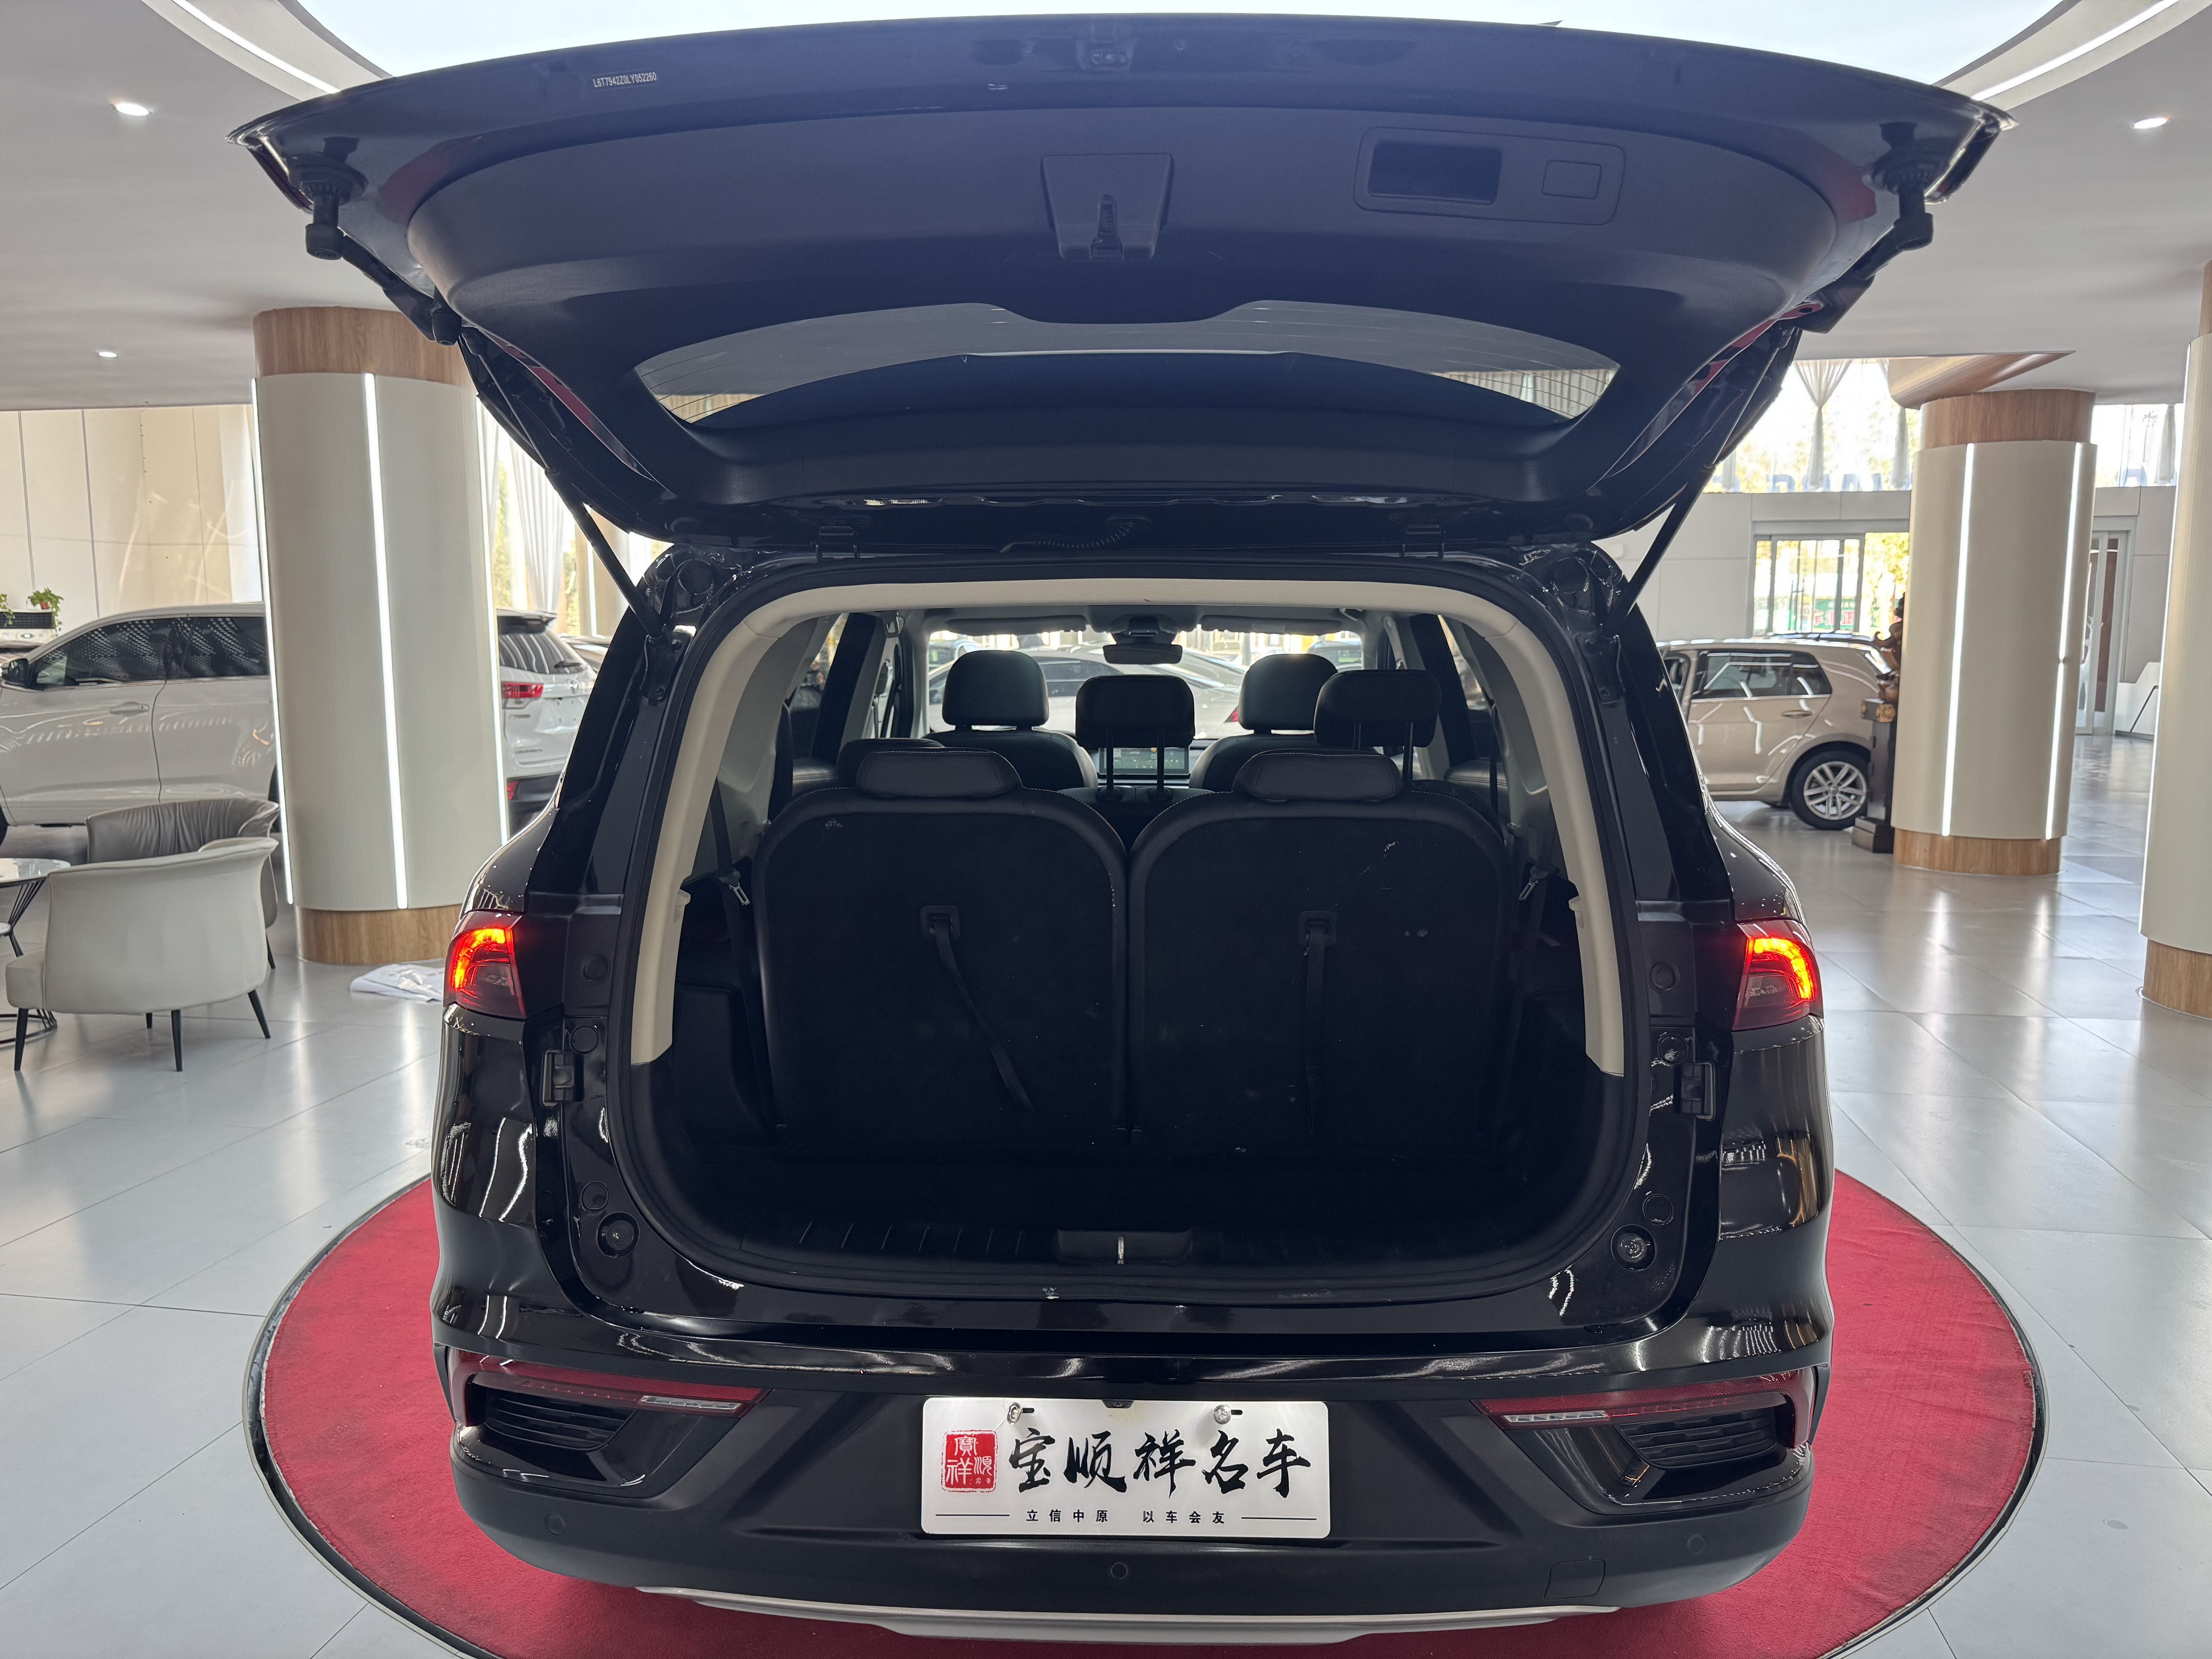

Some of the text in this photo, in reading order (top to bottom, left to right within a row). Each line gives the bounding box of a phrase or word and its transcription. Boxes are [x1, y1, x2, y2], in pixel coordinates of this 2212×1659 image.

[1008, 1427, 1311, 1499] 宝顺祥名车
[1026, 1509, 1224, 1524] 立信中原 以车会友
